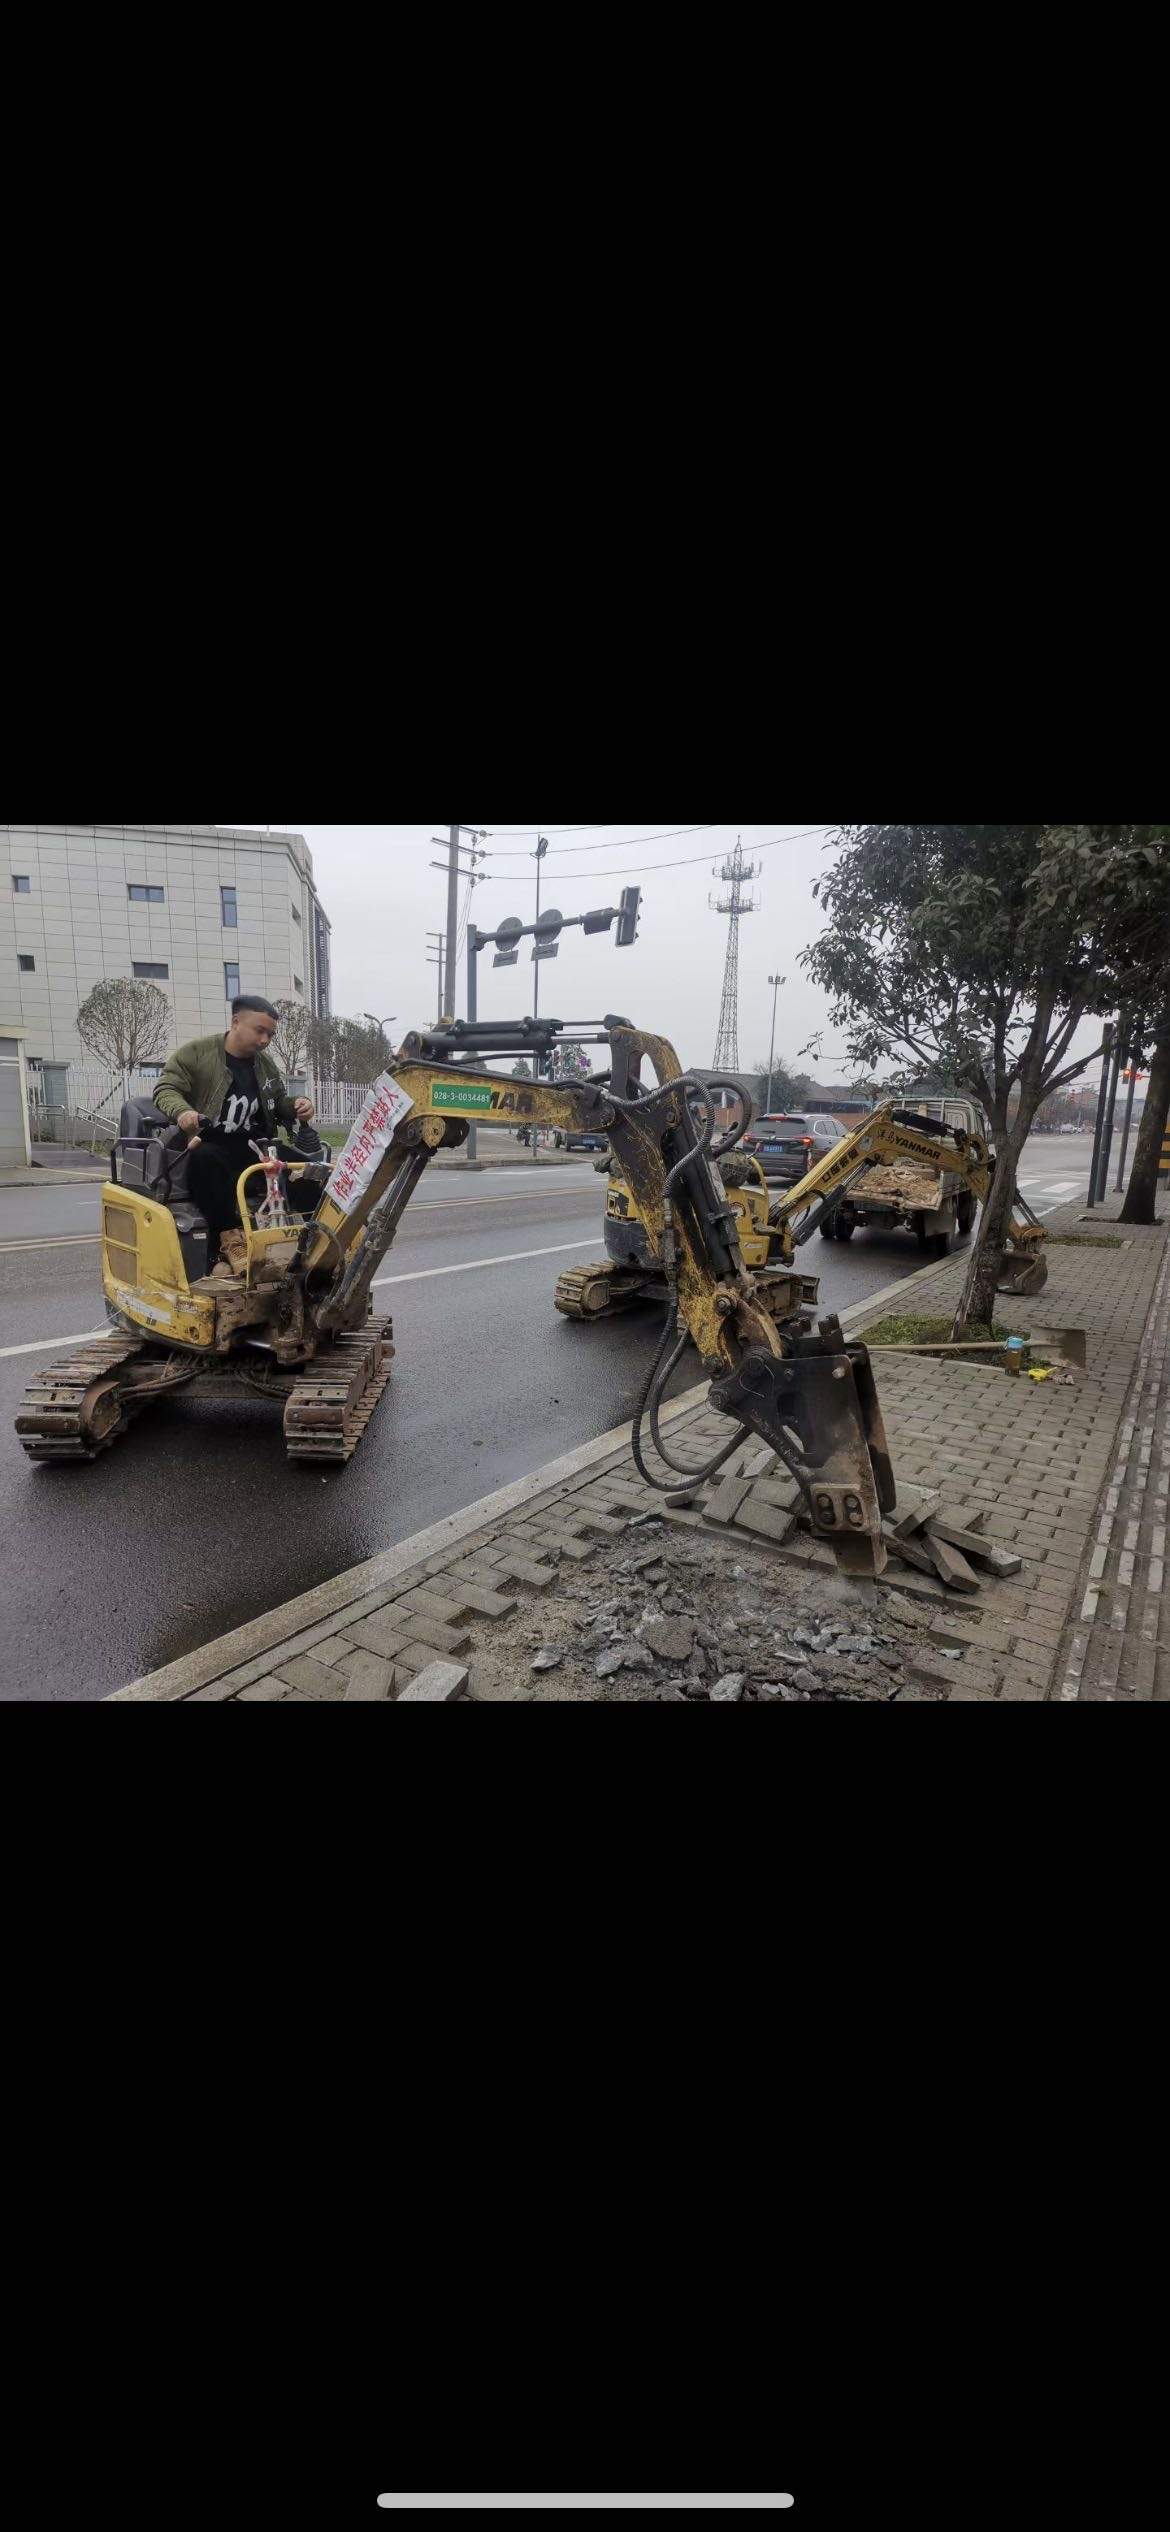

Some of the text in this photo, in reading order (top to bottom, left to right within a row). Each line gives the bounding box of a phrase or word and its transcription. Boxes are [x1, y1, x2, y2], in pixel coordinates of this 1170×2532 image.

[331, 1085, 399, 1201] 作业半径内严禁站人
[895, 1135, 942, 1161] YANMAR
